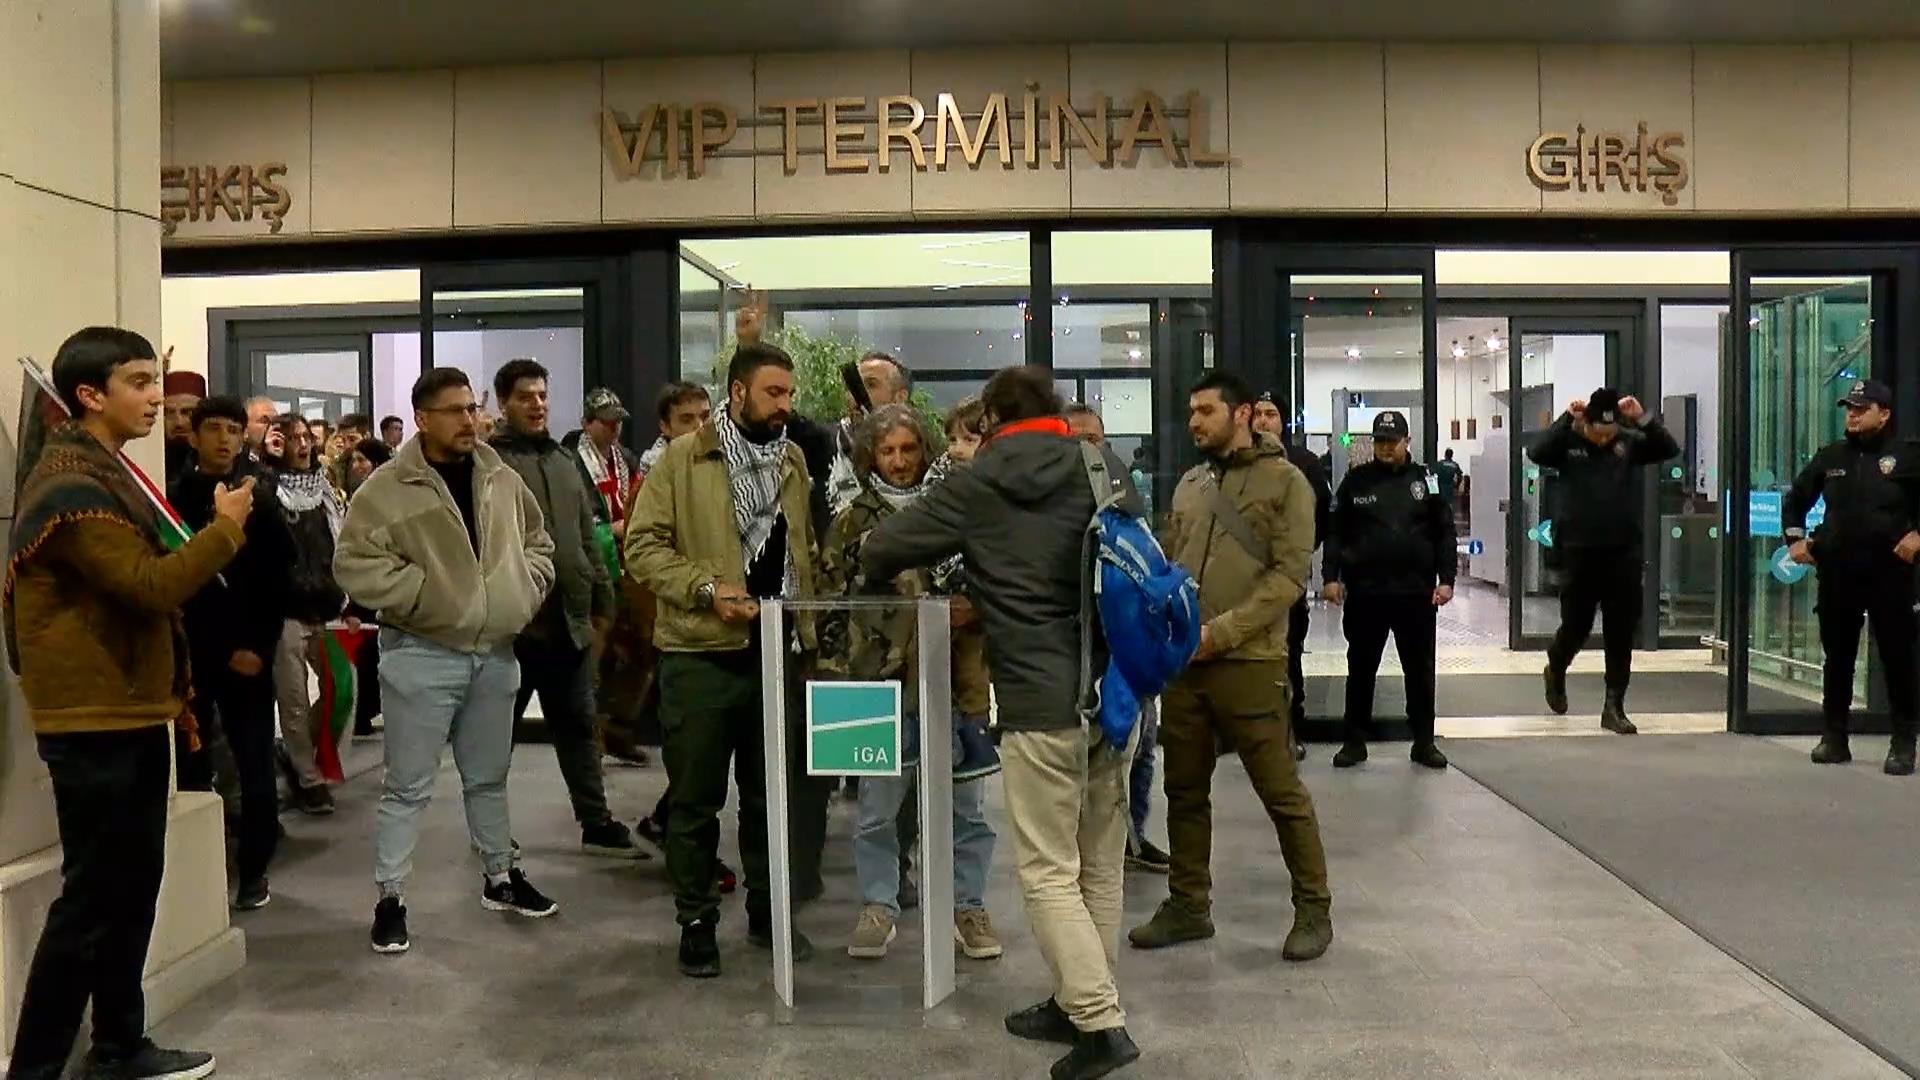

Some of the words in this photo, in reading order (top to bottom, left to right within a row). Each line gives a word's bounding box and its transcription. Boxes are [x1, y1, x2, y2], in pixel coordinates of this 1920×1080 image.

[600, 101, 737, 180] VIP
[760, 80, 1233, 176] TERMİNAL
[1527, 121, 1688, 206] GİRİŞ
